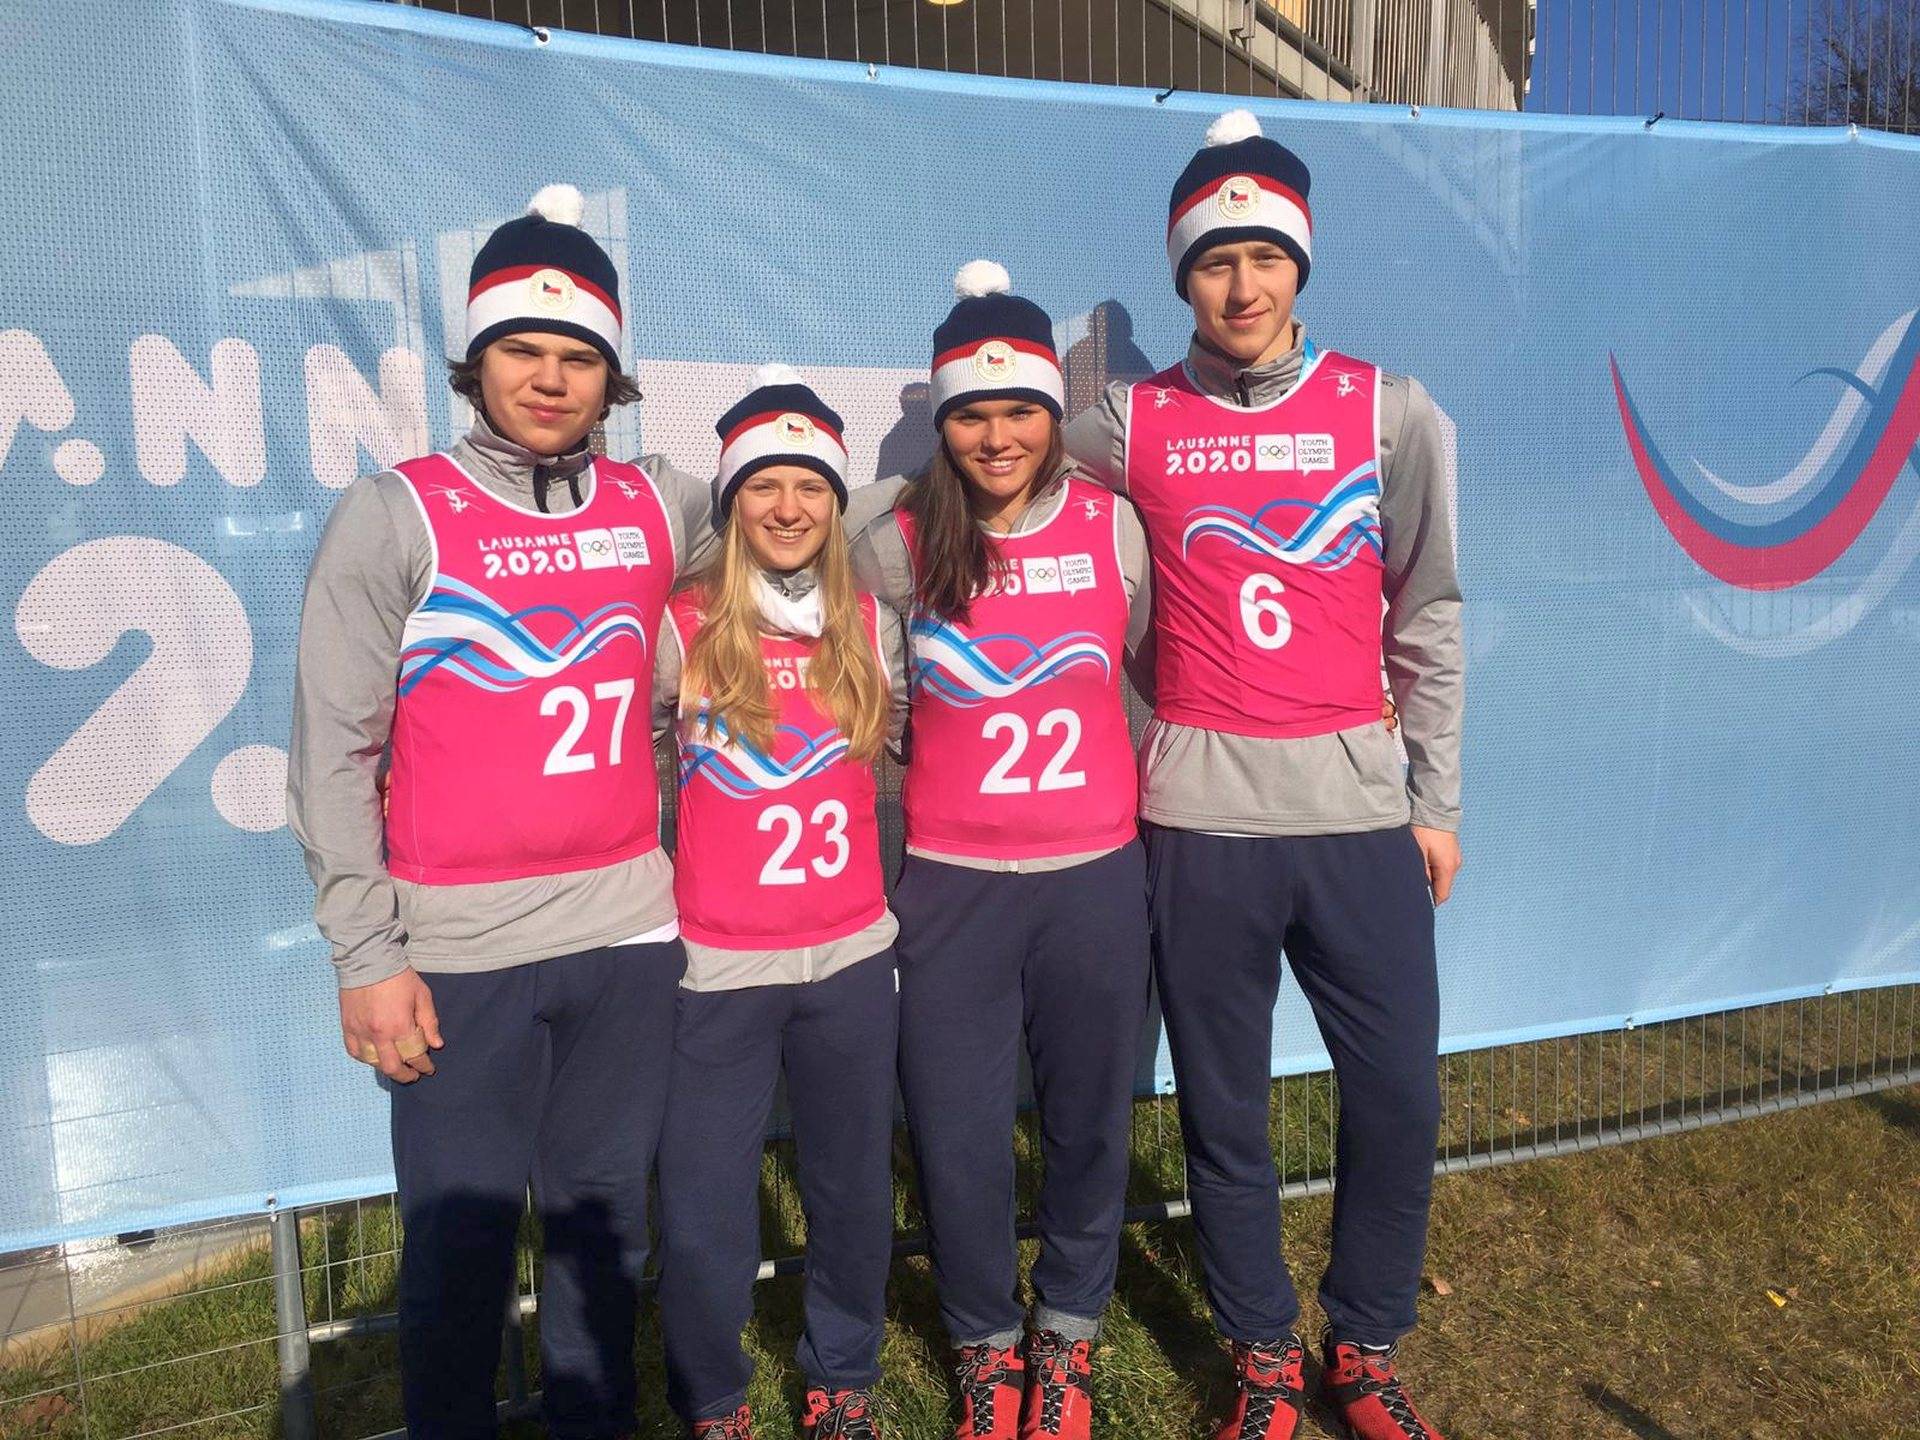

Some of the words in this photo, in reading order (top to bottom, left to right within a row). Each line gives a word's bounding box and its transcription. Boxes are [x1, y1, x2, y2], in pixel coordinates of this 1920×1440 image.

[1166, 435, 1251, 451] LAUSANNE
[1300, 438, 1329, 447] YOUTH
[1297, 447, 1333, 456] OLYMPIC
[1301, 456, 1330, 465] GAMES
[617, 531, 642, 541] YOUTH
[477, 532, 573, 551] LAUSANNE
[617, 541, 646, 550] OLYMPIC
[622, 550, 646, 560] GAMES
[1064, 558, 1088, 567] YOUTH
[1062, 566, 1092, 577] OLYMPIC
[1239, 573, 1293, 650] 6
[539, 678, 635, 776] 27
[979, 708, 1087, 794] 22
[757, 799, 850, 885] 23
